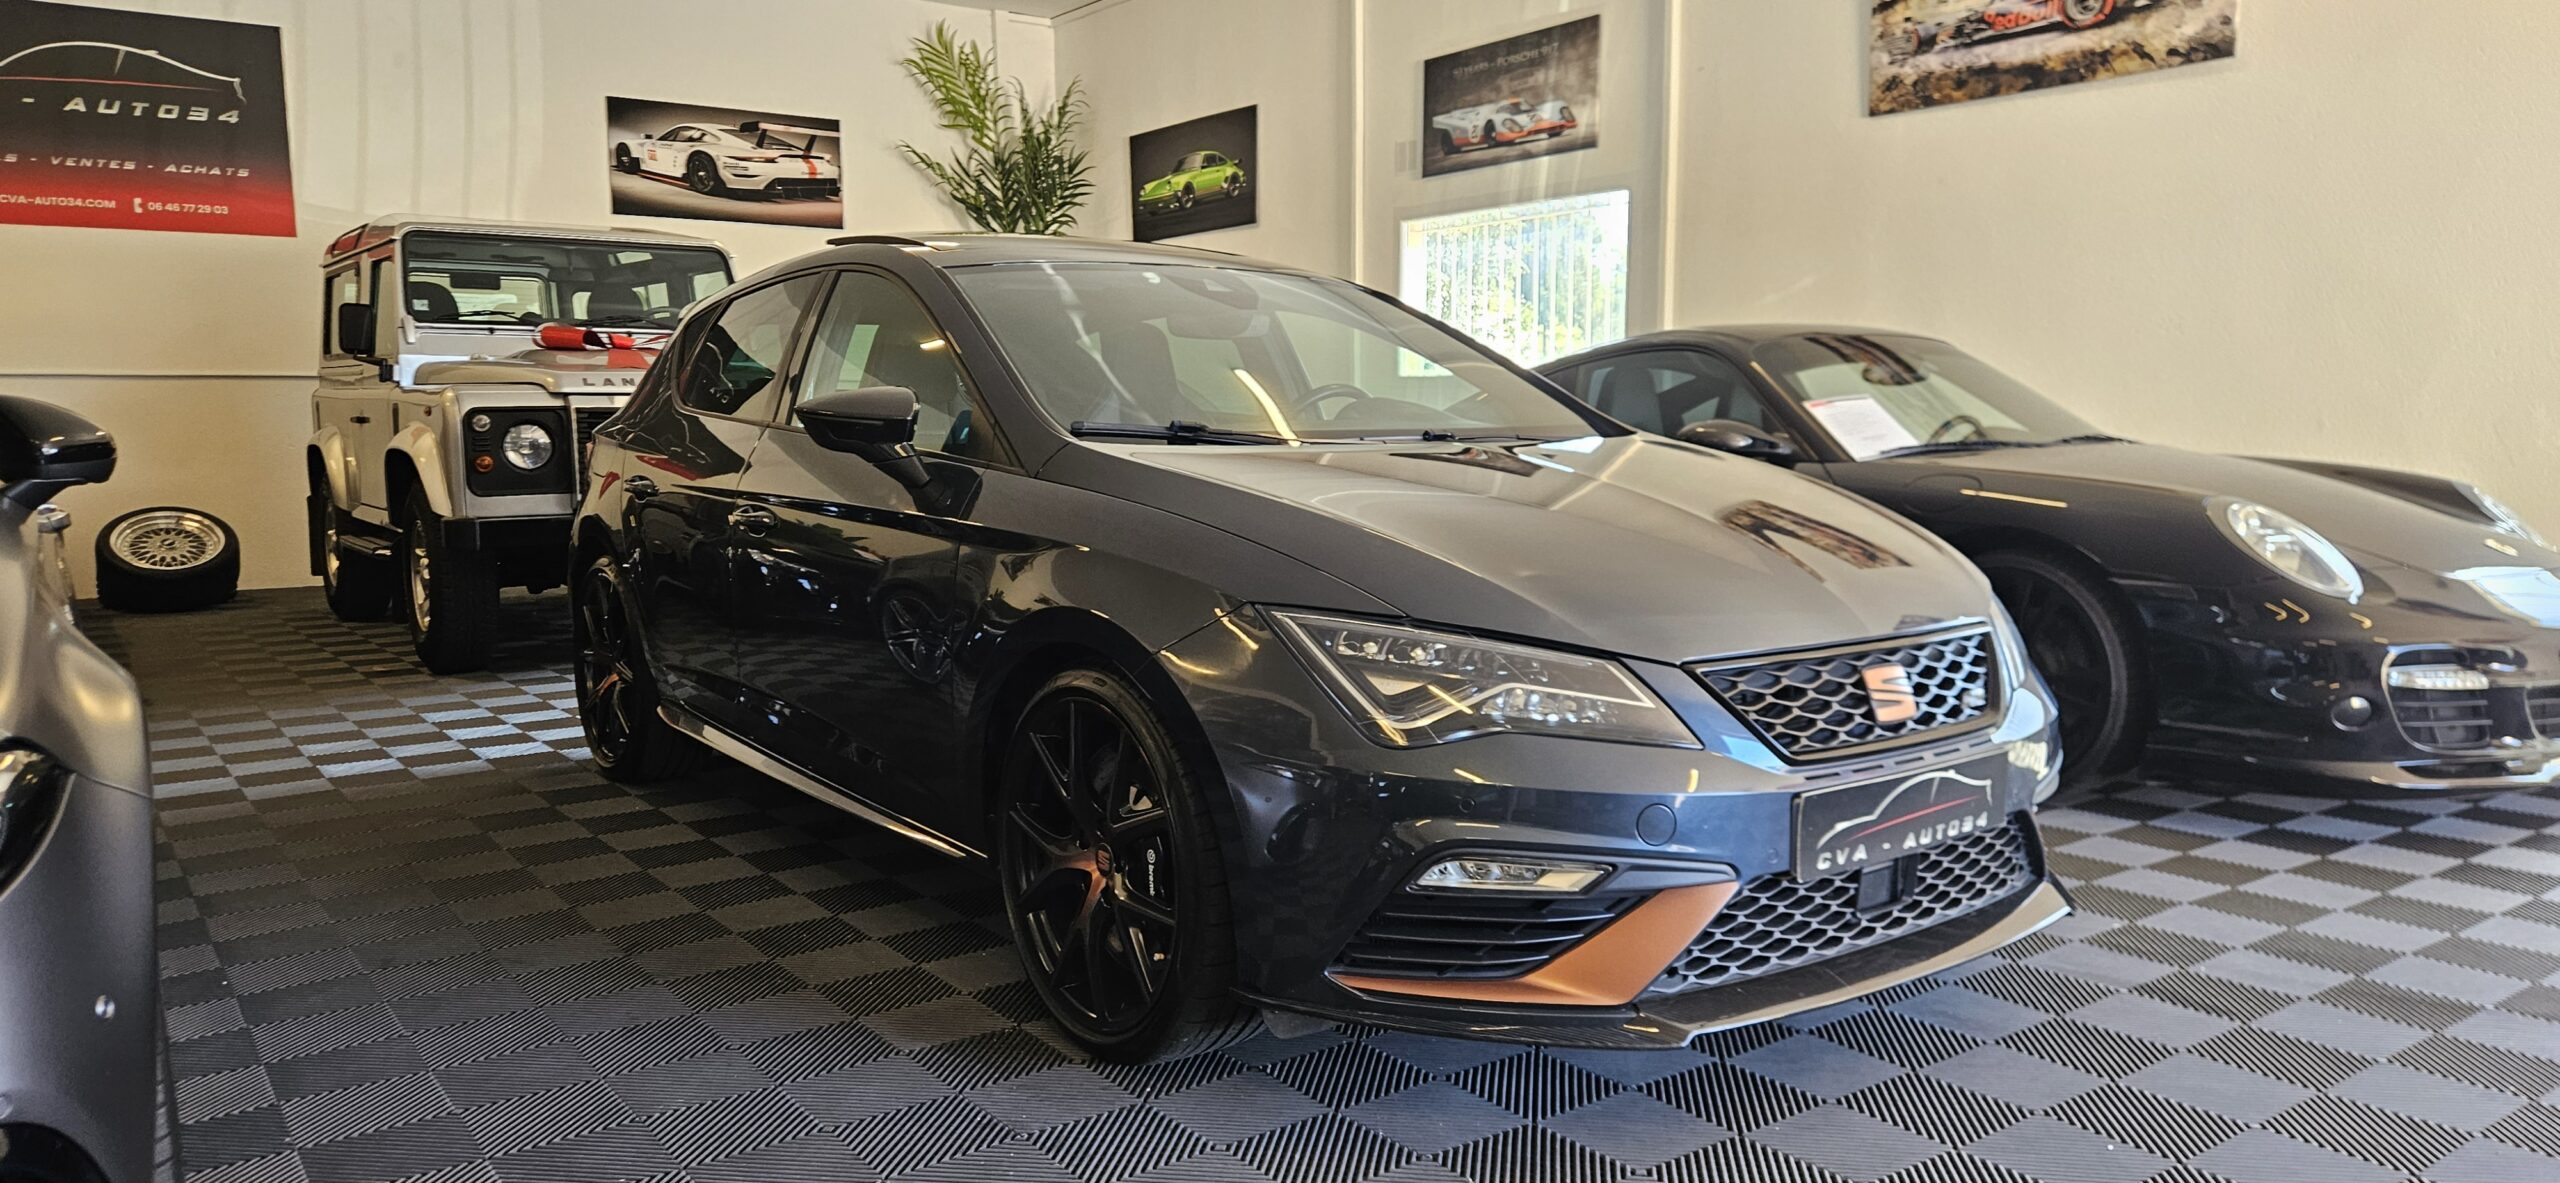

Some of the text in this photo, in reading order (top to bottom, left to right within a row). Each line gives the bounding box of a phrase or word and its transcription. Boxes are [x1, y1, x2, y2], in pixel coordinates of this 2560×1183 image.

[63, 97, 240, 124] AUTO34
[50, 156, 137, 170] VENTES
[164, 164, 250, 177] ACHATS
[147, 202, 163, 211] 06
[181, 203, 196, 213] 77
[197, 205, 212, 214] 29
[213, 206, 229, 215] 03
[582, 377, 636, 387] LAN
[1816, 843, 1868, 871] CVA
[1902, 811, 1988, 850] AUTO34
